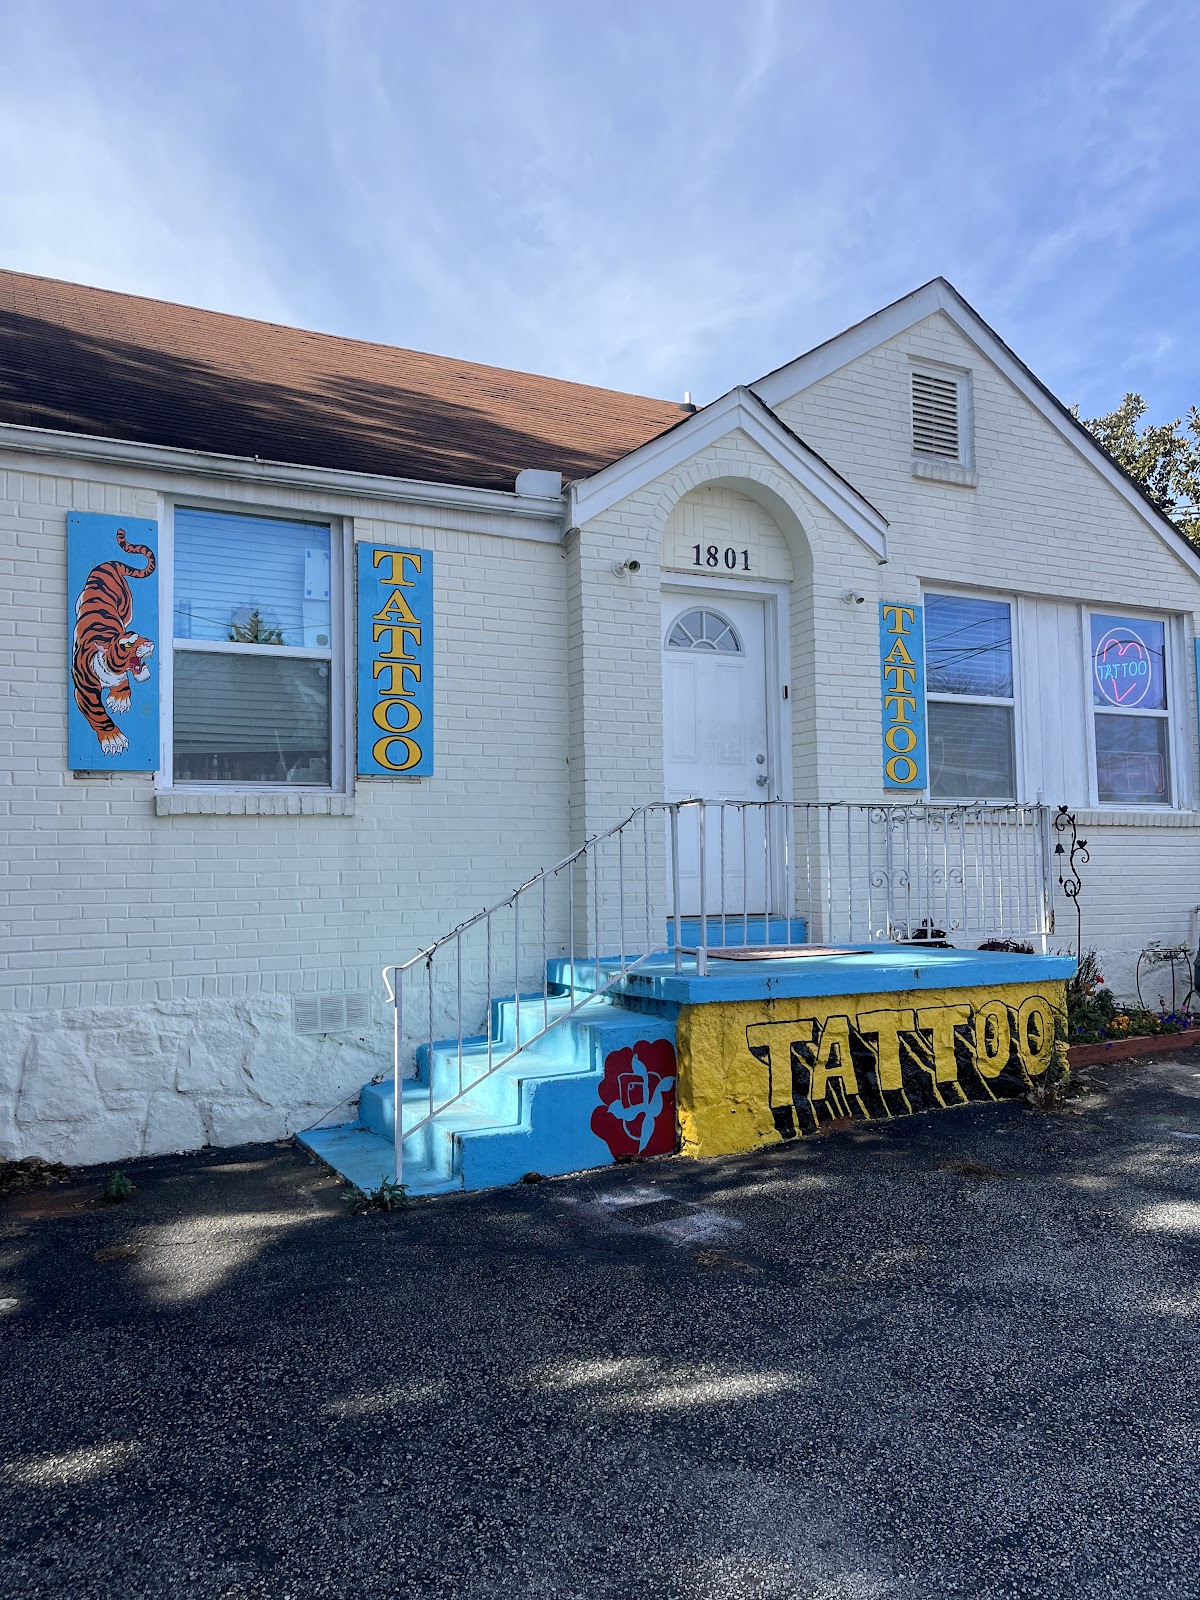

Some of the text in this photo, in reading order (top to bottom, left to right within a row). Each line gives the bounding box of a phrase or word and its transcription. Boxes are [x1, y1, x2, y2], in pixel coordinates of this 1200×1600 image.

[692, 544, 751, 571] 1801
[372, 549, 423, 771] TATTOO
[882, 604, 918, 784] TATTOO
[1097, 660, 1147, 680] TATTOO
[745, 994, 1055, 1109] TATTOO
